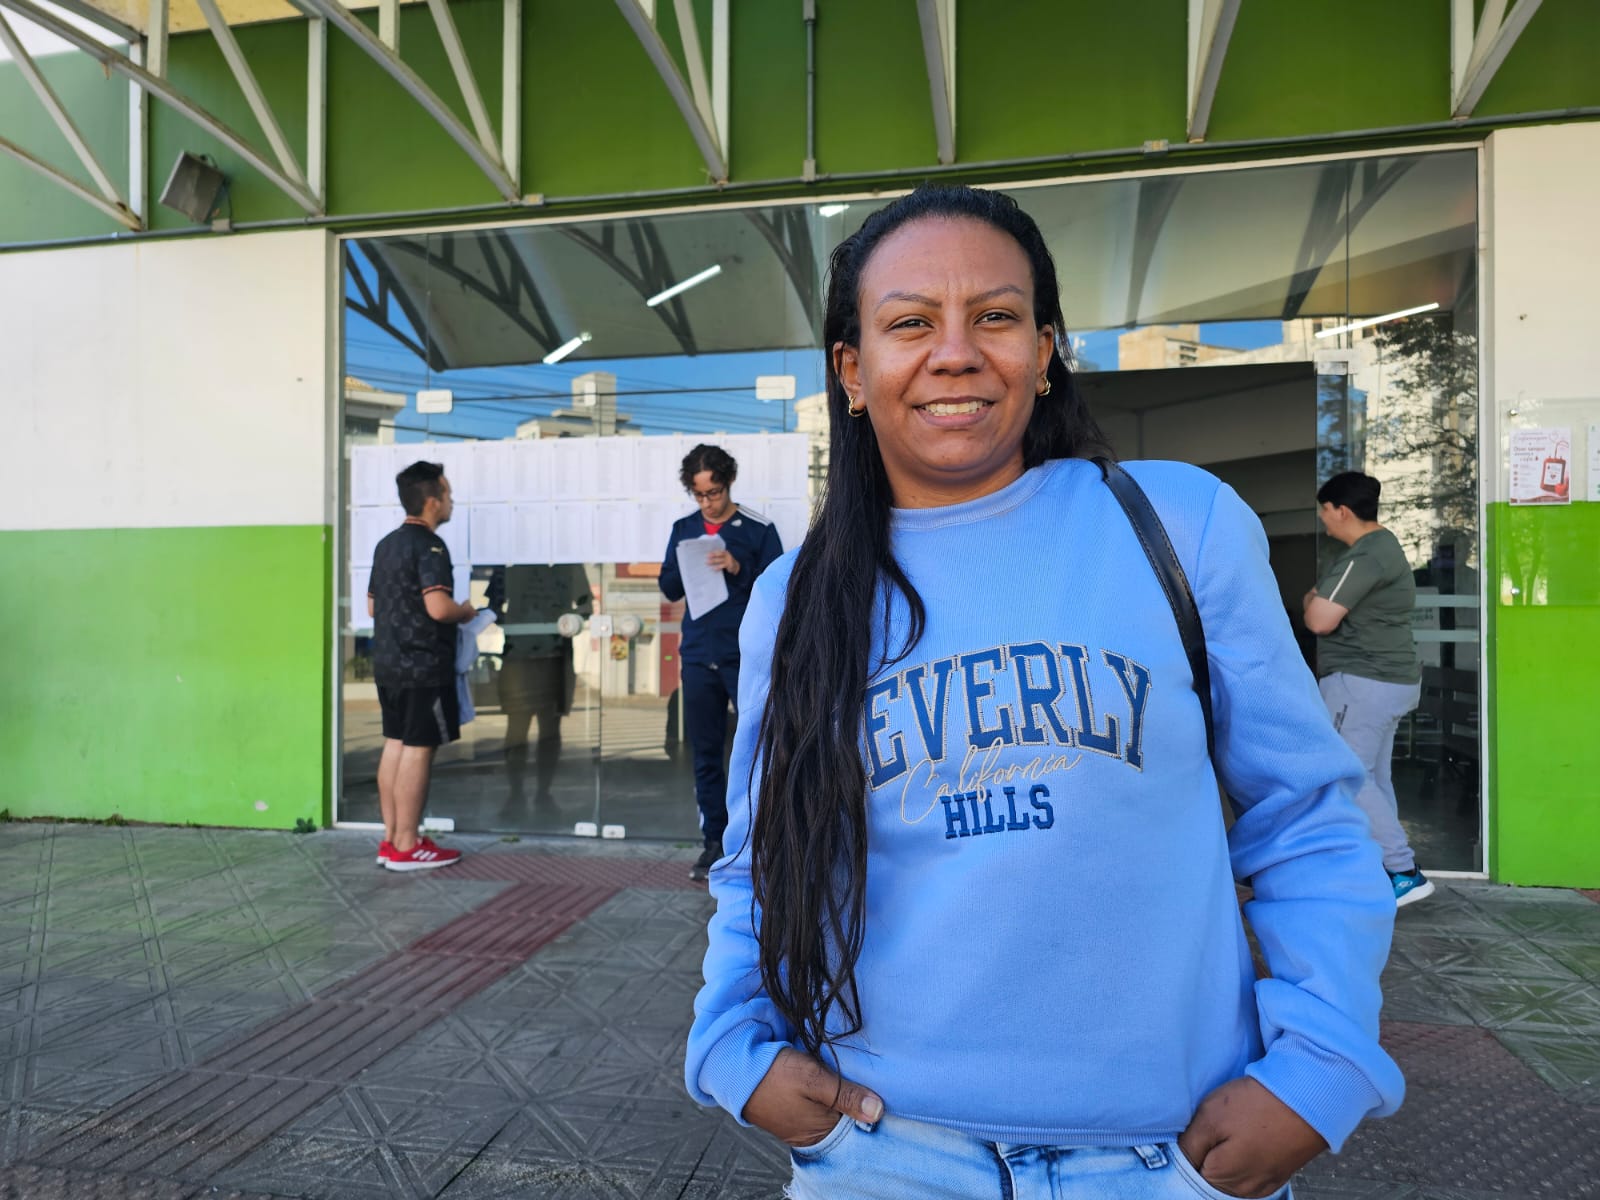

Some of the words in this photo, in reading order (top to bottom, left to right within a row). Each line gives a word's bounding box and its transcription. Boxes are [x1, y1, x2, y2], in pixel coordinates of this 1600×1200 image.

[863, 640, 1152, 792] EVERLY
[901, 738, 1082, 825] California
[940, 784, 1054, 839] HILLS
